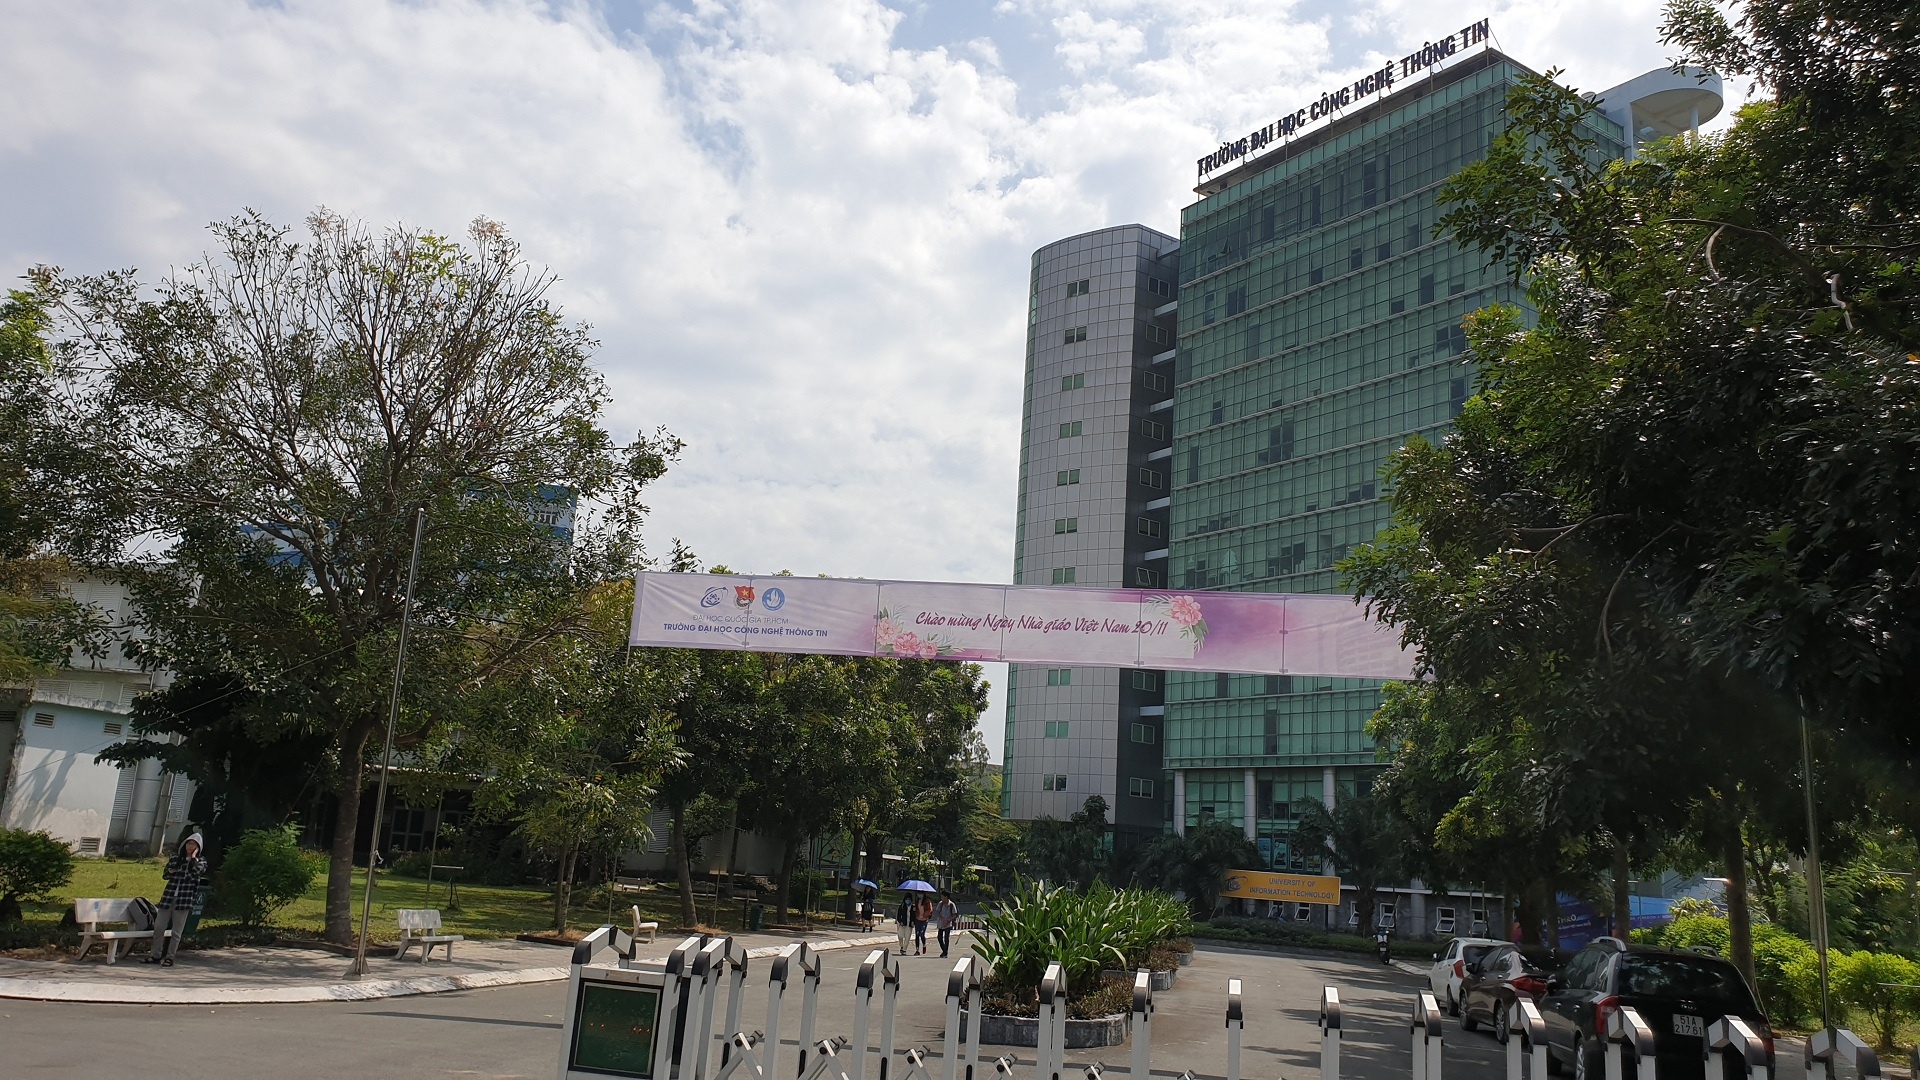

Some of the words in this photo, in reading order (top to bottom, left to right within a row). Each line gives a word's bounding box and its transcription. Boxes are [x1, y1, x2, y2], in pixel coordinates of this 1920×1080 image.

[1197, 137, 1248, 176] TRƯỜNG
[1250, 124, 1273, 149] ĐẠI
[1277, 109, 1306, 138] HỌC
[1310, 87, 1350, 121] CÔNG
[1354, 60, 1394, 101] NGHỆ
[1400, 35, 1456, 78] THÔNG
[1460, 17, 1489, 49] TIN
[663, 622, 696, 631] TRƯỜNG
[698, 624, 712, 634] ĐẠI
[713, 625, 732, 635] HỌC
[734, 624, 759, 635] CÔNG
[761, 626, 784, 637] NGHỆ
[785, 627, 814, 637] THÔNG
[815, 629, 828, 637] TIN
[915, 611, 946, 625] Chào
[947, 613, 982, 630] mừng
[983, 613, 1015, 633] Ngày
[1017, 614, 1043, 630] Nhà
[1043, 618, 1072, 633] giáo
[1074, 617, 1099, 634] Việt
[1100, 618, 1131, 633] Nam
[1131, 619, 1169, 636] 20/11
[1269, 878, 1306, 886] UNIVERSITY
[1249, 887, 1291, 896] INFORMATION
[1293, 890, 1335, 899] TECHNOLOGY
[1680, 1015, 1697, 1026] 51A
